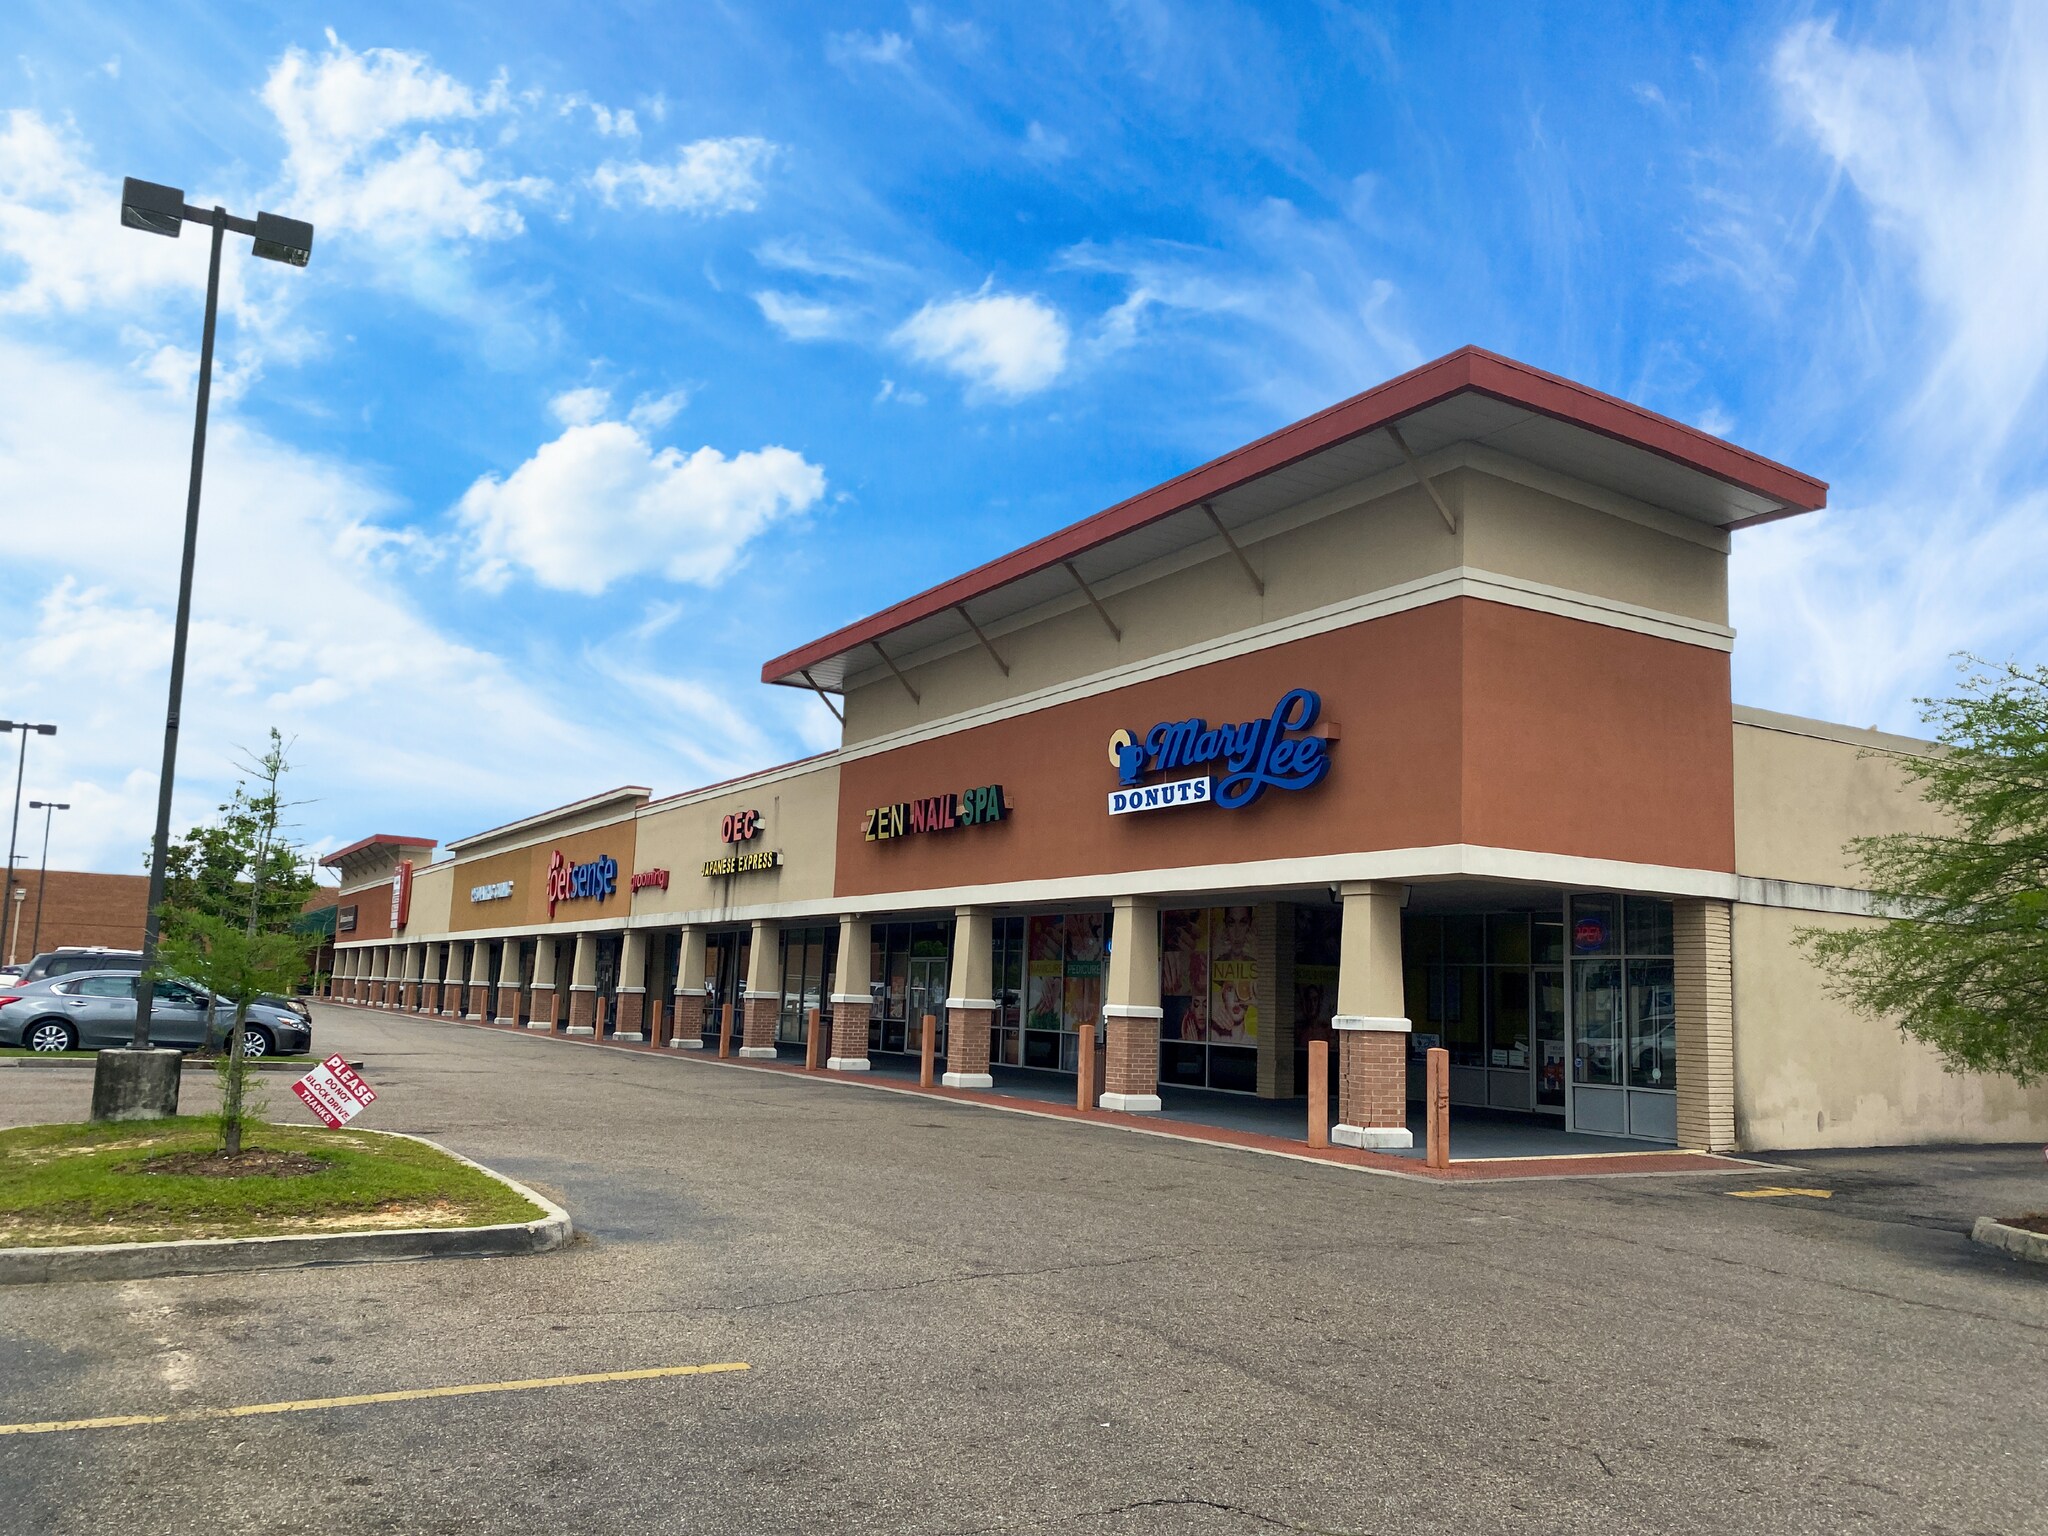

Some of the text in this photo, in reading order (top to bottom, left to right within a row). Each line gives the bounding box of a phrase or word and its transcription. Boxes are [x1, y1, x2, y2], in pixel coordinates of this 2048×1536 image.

[1146, 688, 1330, 809] Mary Lee
[1113, 780, 1206, 811] DONUTS
[721, 810, 758, 843] OEC
[865, 785, 1002, 842] ZEN NAIL SPA
[701, 851, 775, 877] JAPANESE EXPRESS
[631, 868, 669, 894] grooming
[1067, 964, 1100, 975] PEDICURE
[1214, 962, 1259, 980] NAILS
[325, 1078, 352, 1103] DO NOT
[326, 1056, 375, 1105] PLEASE
[300, 1090, 334, 1124] THANKS!
[305, 1075, 350, 1120] BLOCK DRIVE
